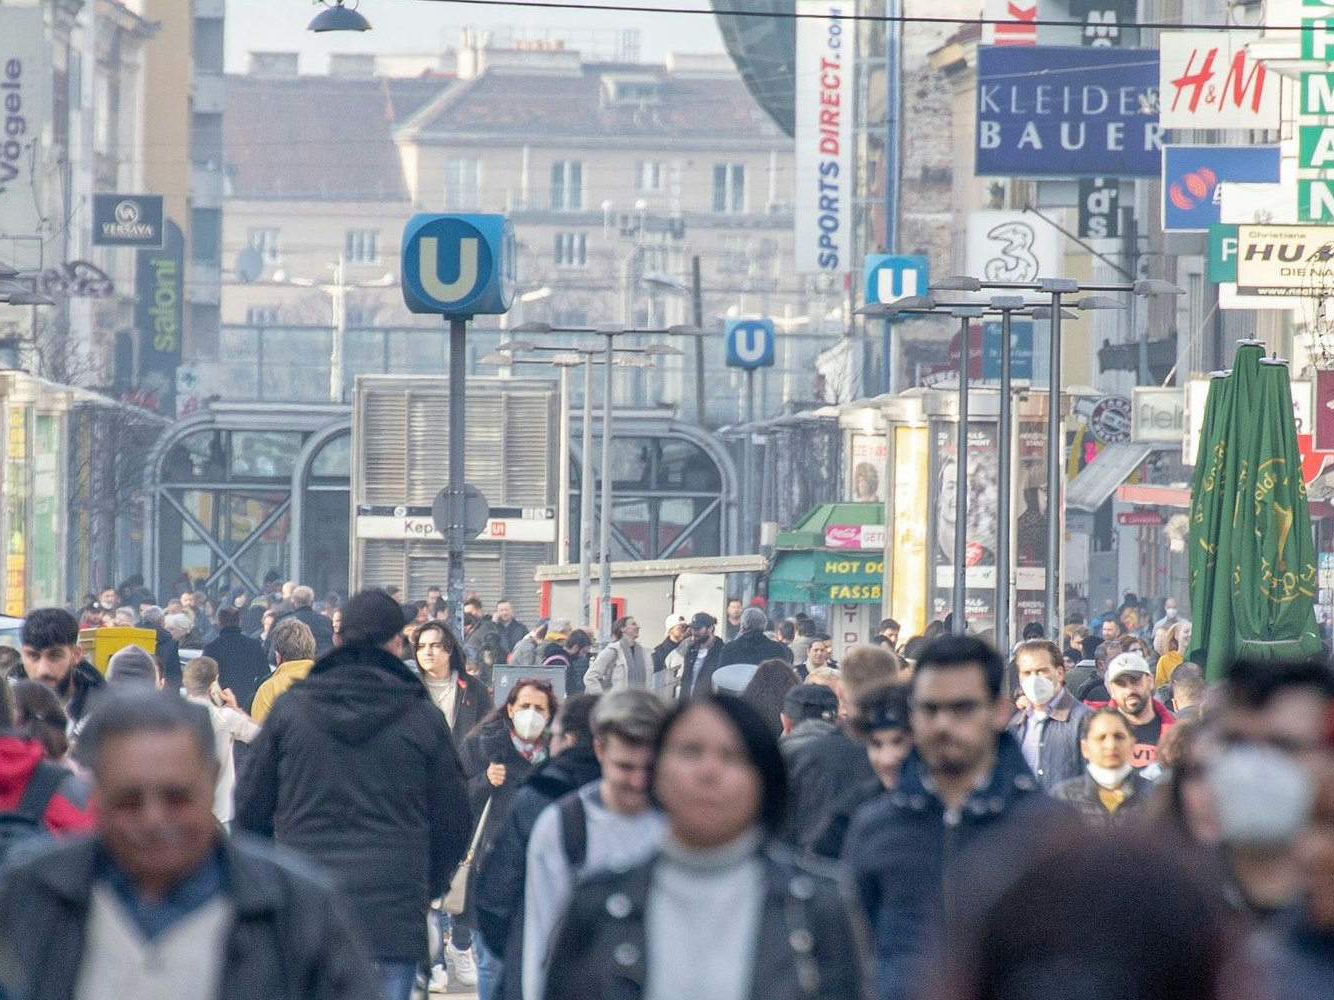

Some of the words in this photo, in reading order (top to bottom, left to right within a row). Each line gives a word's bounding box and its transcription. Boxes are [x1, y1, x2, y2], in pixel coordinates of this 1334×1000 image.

[1170, 47, 1266, 114] H&M
[0, 57, 27, 184] Vögele
[979, 120, 1165, 151] BAUER
[101, 222, 154, 236] VERSAVA
[817, 160, 840, 271] SPORTS
[1249, 231, 1307, 239] Christiane
[419, 237, 478, 303] U
[878, 268, 917, 304] U
[734, 329, 765, 362] U
[825, 561, 860, 574] HOT
